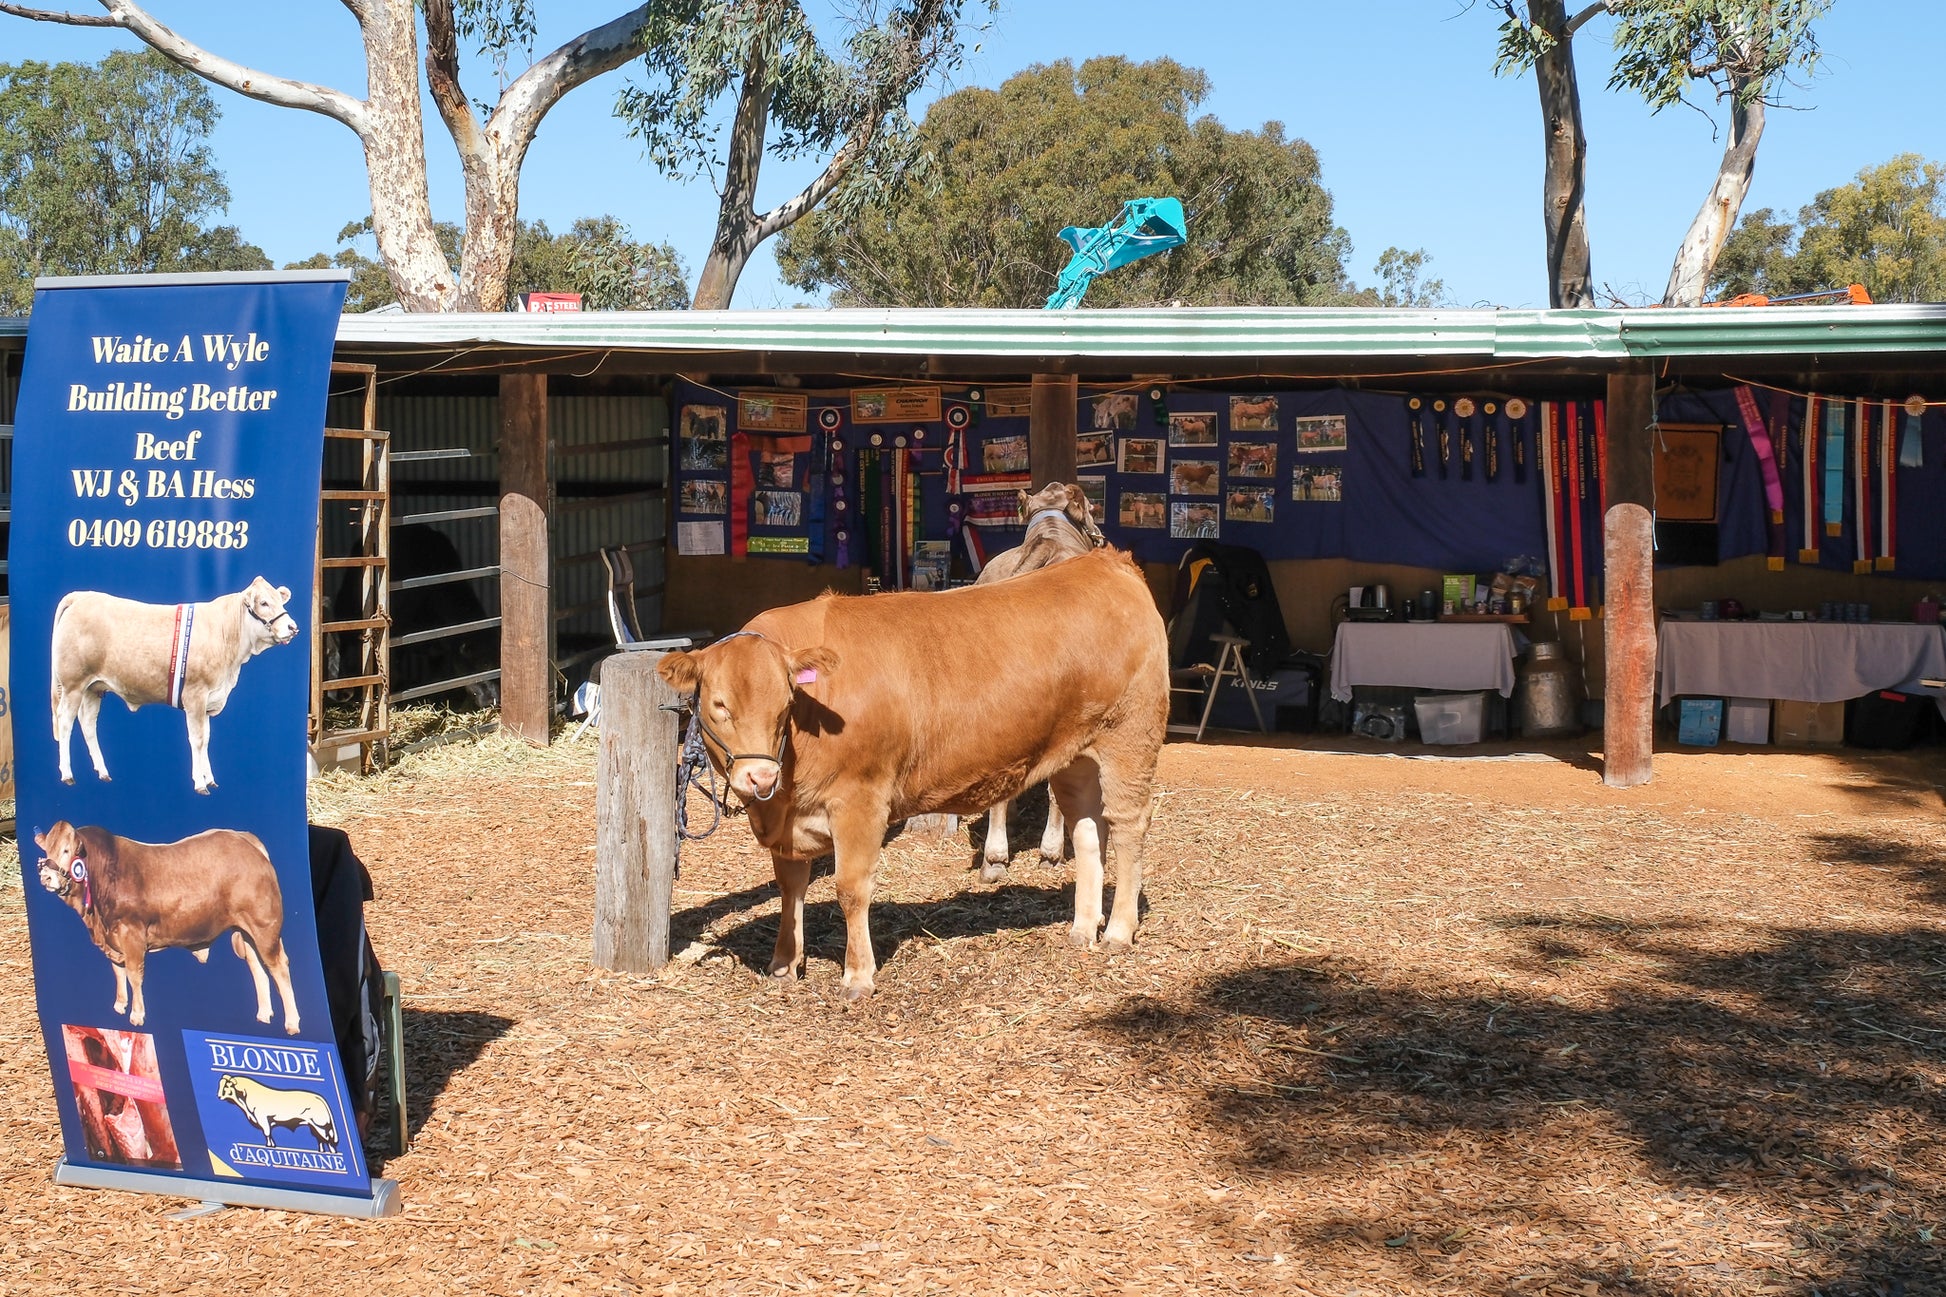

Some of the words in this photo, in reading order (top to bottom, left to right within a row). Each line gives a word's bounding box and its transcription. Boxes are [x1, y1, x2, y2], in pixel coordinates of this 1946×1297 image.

[92, 334, 169, 364] Waite
[173, 335, 194, 362] A
[202, 333, 270, 370] Wyle
[67, 382, 187, 420] Building
[189, 383, 278, 412] Better
[134, 430, 202, 461] Beef
[71, 470, 113, 499] WJ
[117, 469, 141, 506] &
[146, 470, 185, 499] BA
[190, 470, 256, 499] Hess
[68, 518, 141, 548] 0409
[146, 519, 249, 550] 619883
[209, 1044, 321, 1076] BLONDE
[229, 1143, 347, 1171] d'AQUITAINE
